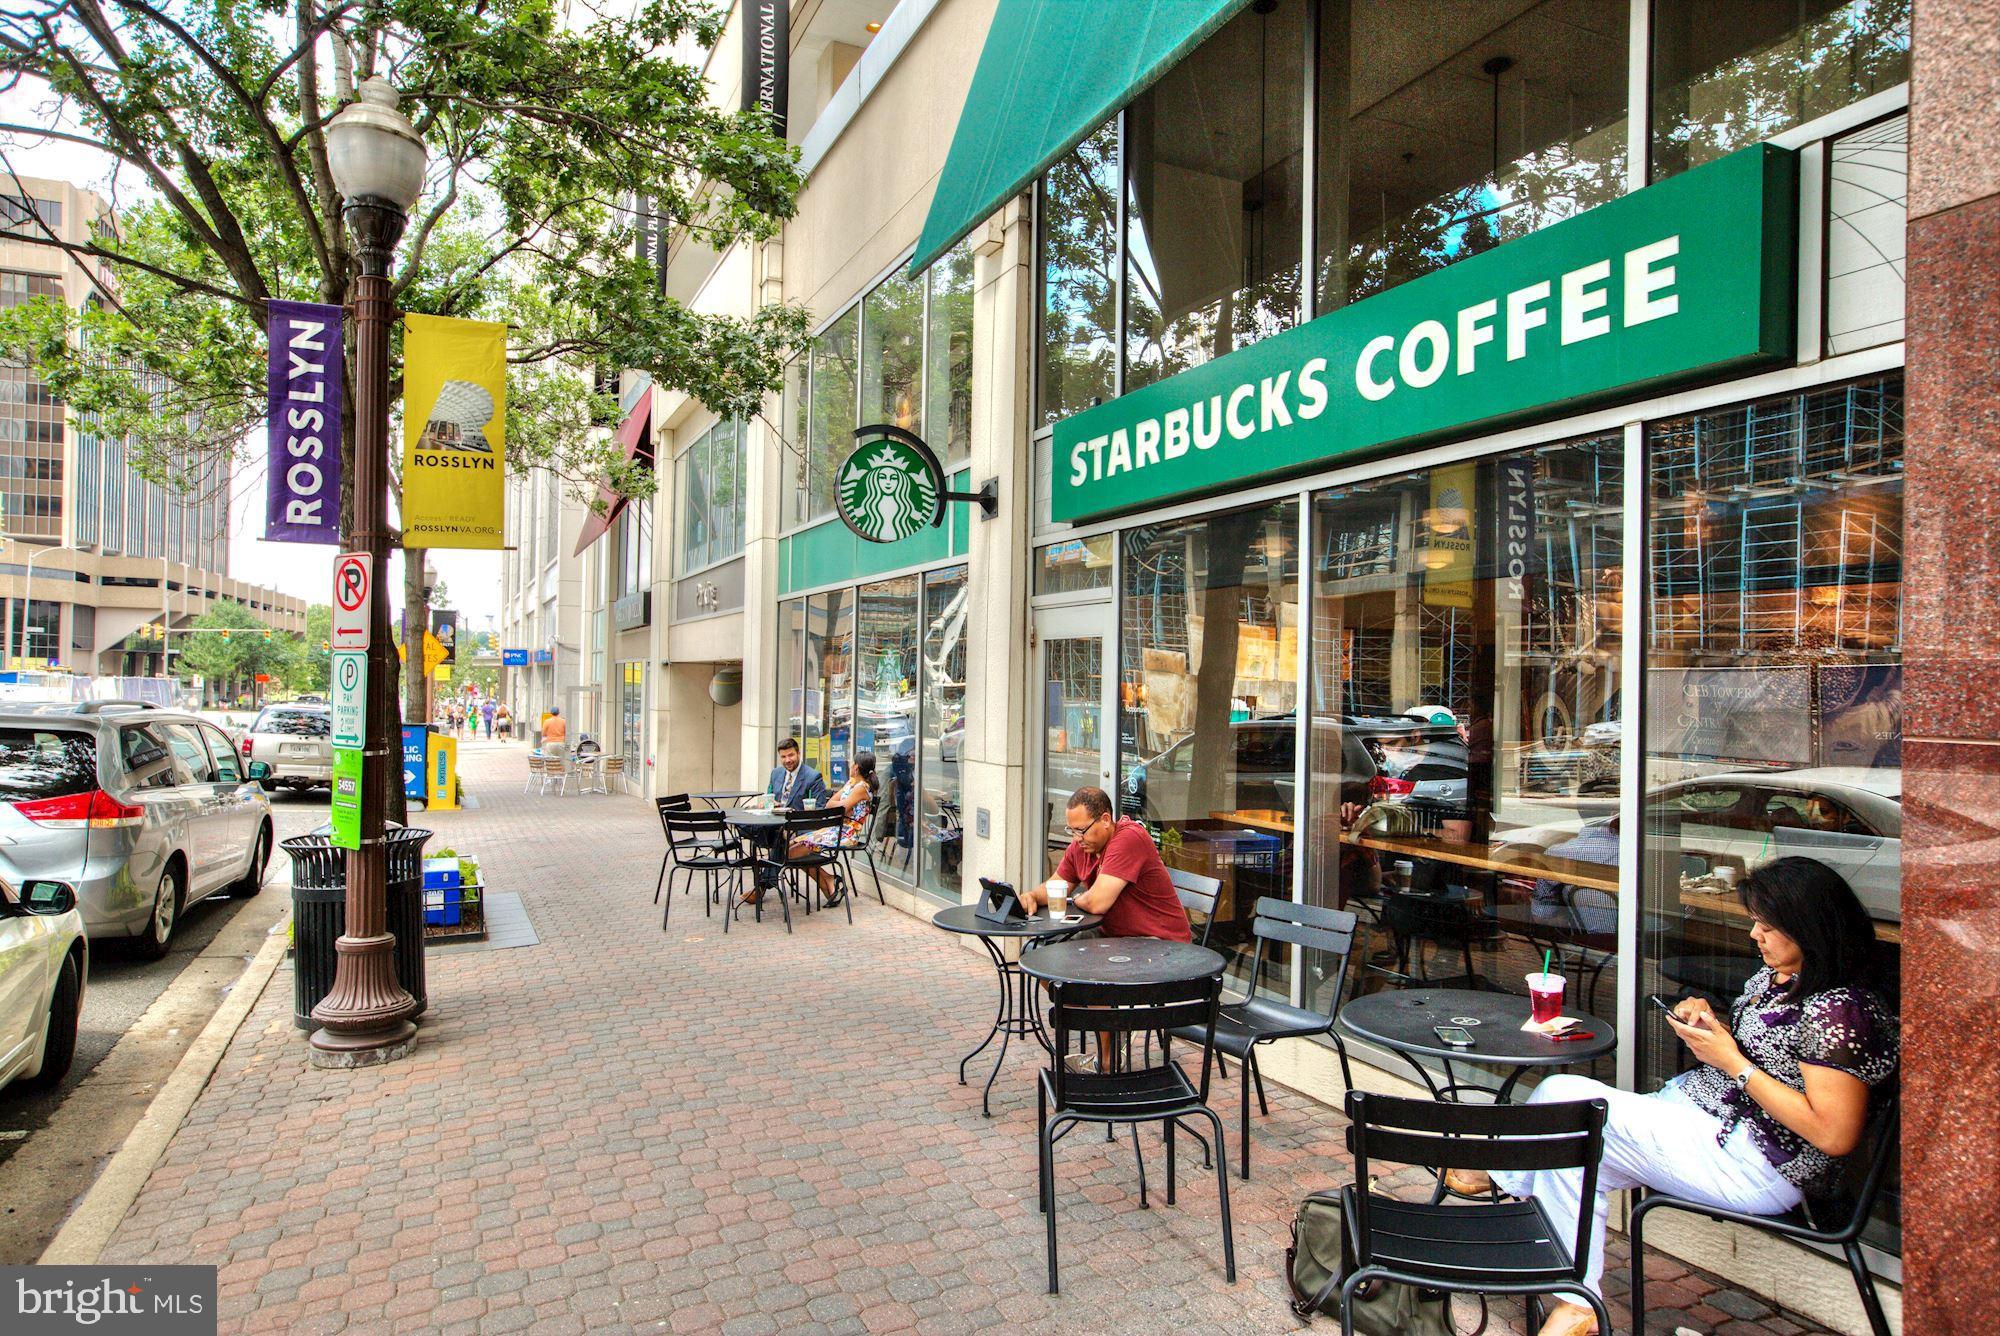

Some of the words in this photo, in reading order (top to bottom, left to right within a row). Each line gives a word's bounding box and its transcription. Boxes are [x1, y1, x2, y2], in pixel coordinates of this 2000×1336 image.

[760, 3, 775, 113] ERNATIONAL
[1070, 357, 1329, 487] STARBUCKS
[1355, 234, 1680, 402] COFFEE
[286, 319, 325, 525] ROSSLYN
[414, 454, 495, 470] ROSSLYN
[425, 642, 435, 651] AL
[346, 664, 354, 687] P
[343, 693, 353, 702] PAY
[1711, 684, 1752, 698] TOWER
[337, 705, 359, 716] PARKING
[403, 745, 419, 754] LIC
[338, 779, 356, 792] 54557
